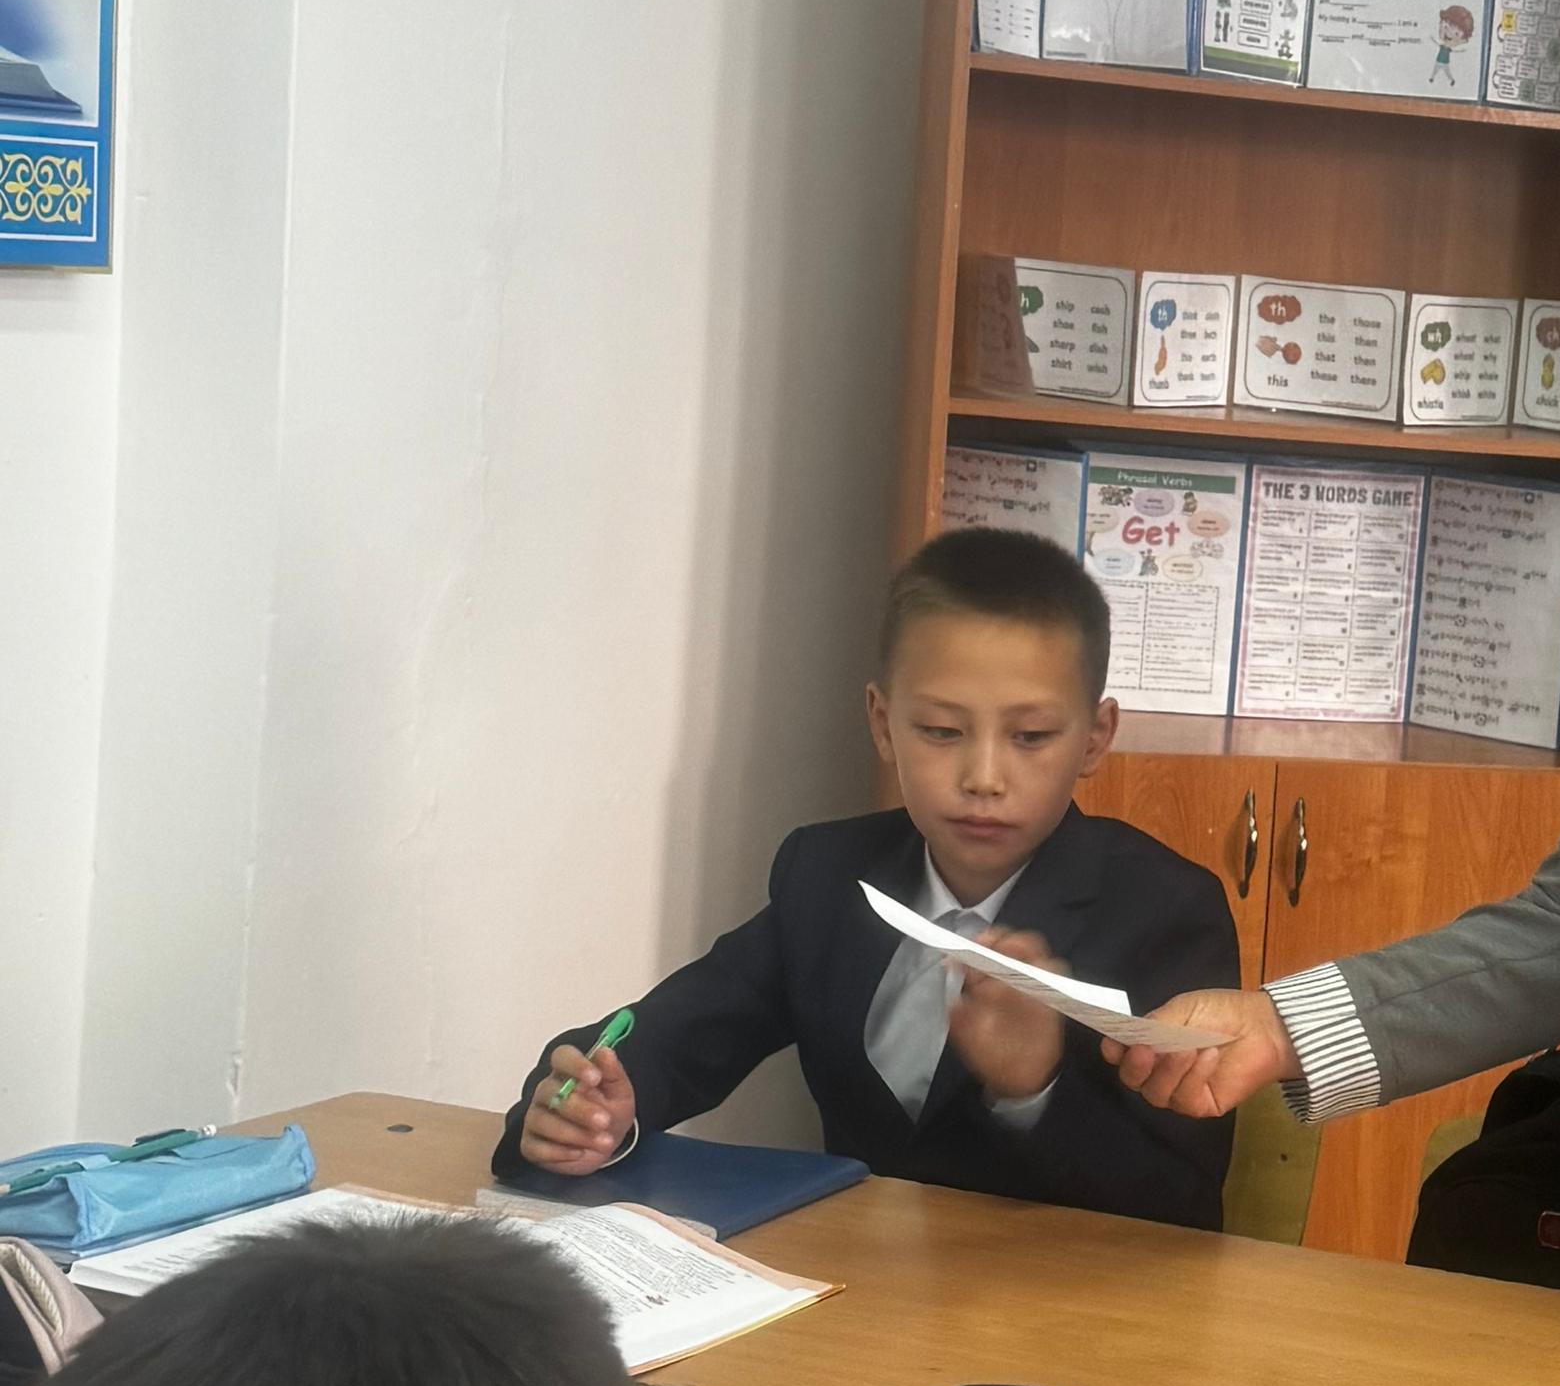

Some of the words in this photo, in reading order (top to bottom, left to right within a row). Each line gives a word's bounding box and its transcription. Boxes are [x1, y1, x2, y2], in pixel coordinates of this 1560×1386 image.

[1270, 301, 1287, 317] th
[1319, 313, 1336, 325] the
[1267, 374, 1289, 388] this
[1162, 475, 1193, 487] Verbs
[1262, 481, 1294, 500] THE
[1299, 484, 1311, 500] 3
[1315, 486, 1368, 505] WORDS
[1372, 490, 1414, 507] GAME
[1121, 515, 1180, 547] Get
